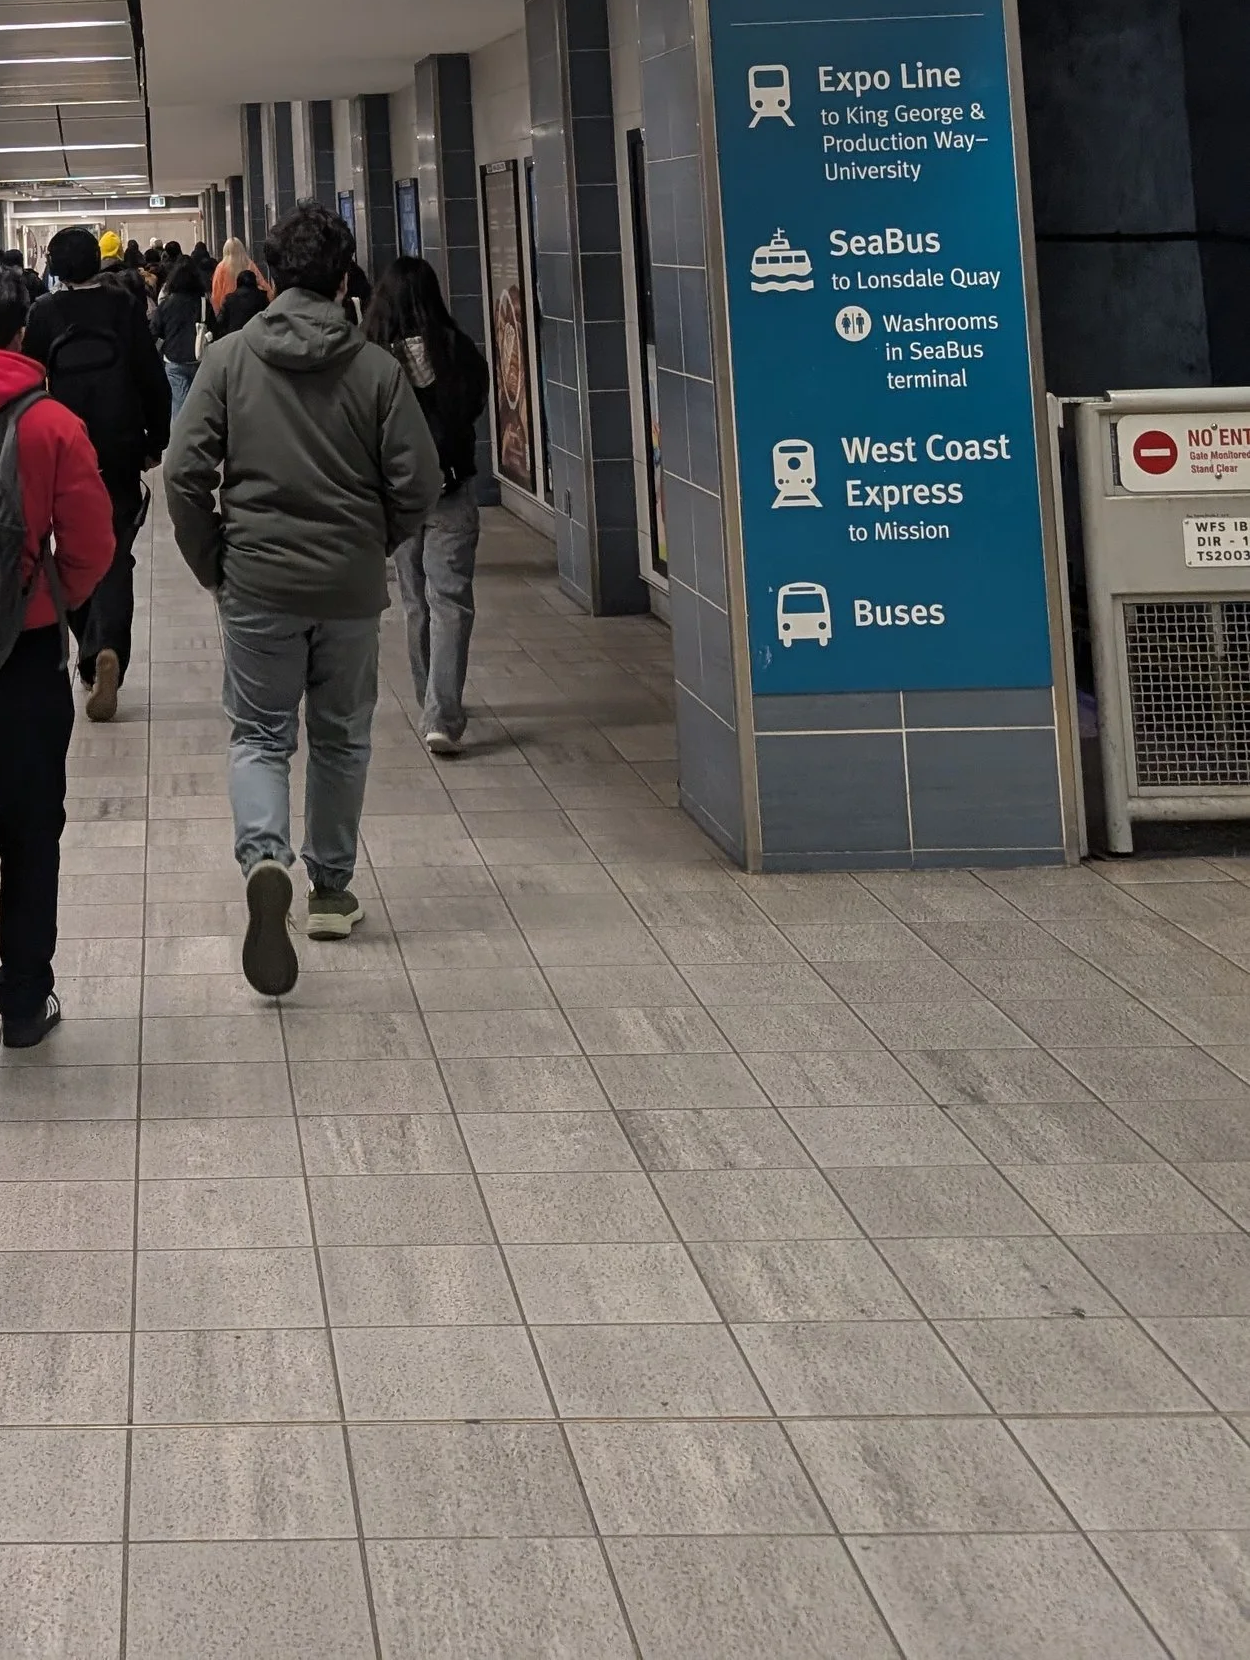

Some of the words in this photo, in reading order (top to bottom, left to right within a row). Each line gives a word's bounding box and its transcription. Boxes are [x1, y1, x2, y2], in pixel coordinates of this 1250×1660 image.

[819, 66, 890, 97] Expo
[901, 62, 960, 88] Line
[821, 109, 839, 125] to
[847, 106, 888, 127] King
[895, 105, 963, 124] George
[971, 103, 985, 119] &
[824, 133, 927, 152] Production
[825, 160, 921, 182] University
[830, 228, 940, 256] SeaBus
[832, 274, 850, 290] to
[858, 268, 943, 289] Lonsdale
[951, 268, 1000, 289] Quay
[883, 313, 998, 332] Washrooms
[886, 343, 902, 360] in
[910, 341, 983, 360] SeaBus
[887, 368, 967, 389] terminal
[1187, 428, 1214, 448] NO
[841, 437, 917, 463] West
[926, 434, 1010, 461] Coast
[1189, 451, 1209, 461] Gate
[1190, 465, 1214, 474] Stand
[1216, 463, 1238, 474] Clear
[846, 480, 963, 512] Express
[849, 525, 867, 541] to
[875, 521, 949, 540] Mission
[1195, 521, 1226, 533] WFS
[1197, 536, 1222, 547] DIR
[854, 600, 944, 626] Buses
